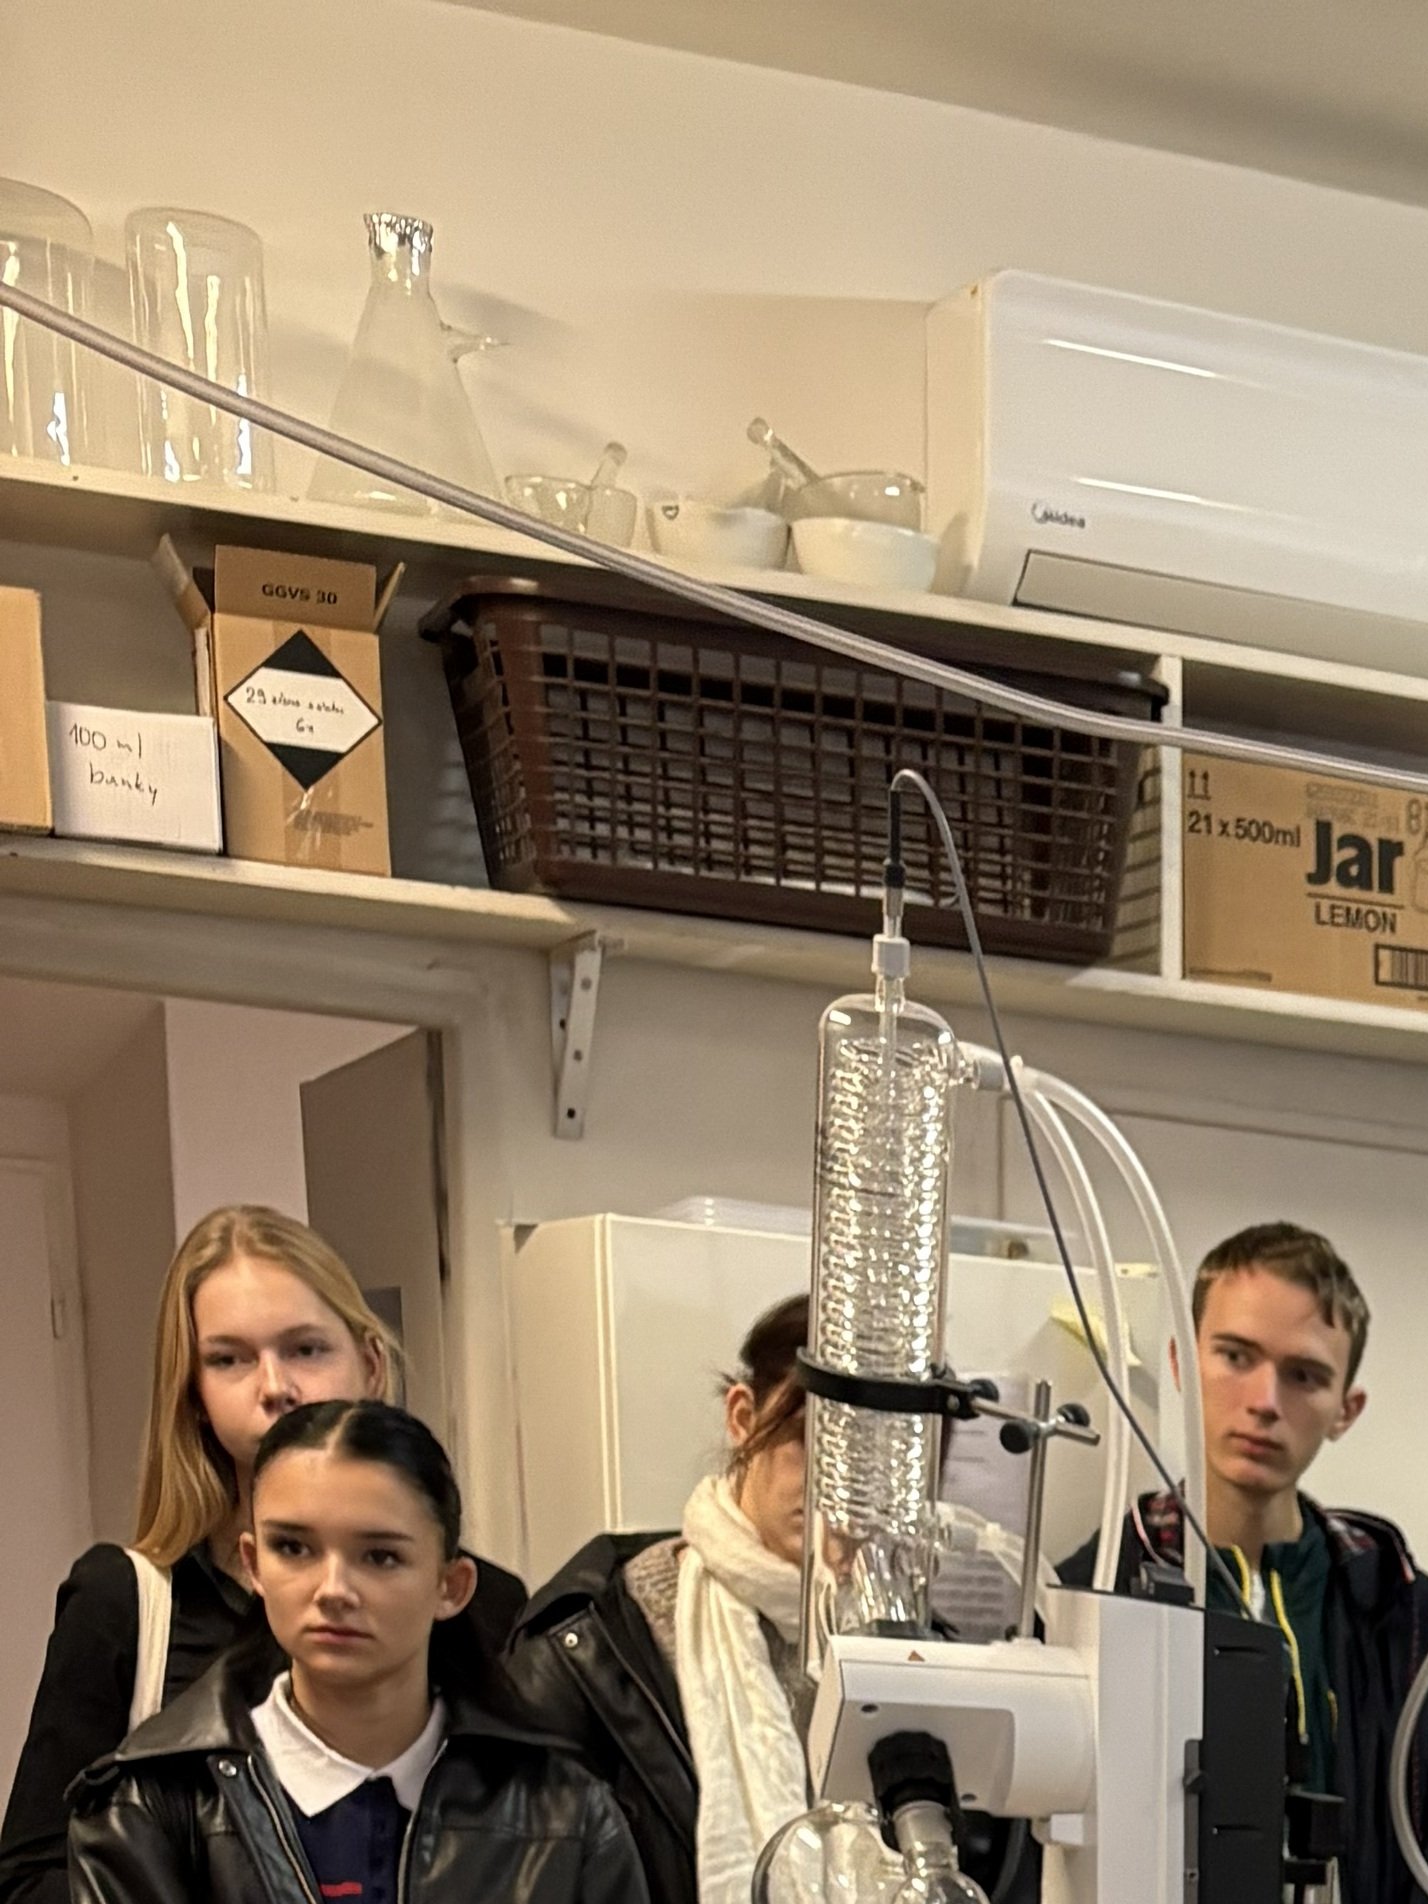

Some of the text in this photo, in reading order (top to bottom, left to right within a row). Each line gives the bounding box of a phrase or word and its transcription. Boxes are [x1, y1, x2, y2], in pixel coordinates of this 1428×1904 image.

[69, 722, 107, 752] 100
[1187, 811, 1214, 835] 21
[1234, 818, 1301, 848] 500ml
[1306, 818, 1405, 895] Jar
[1314, 901, 1397, 934] LEMON
